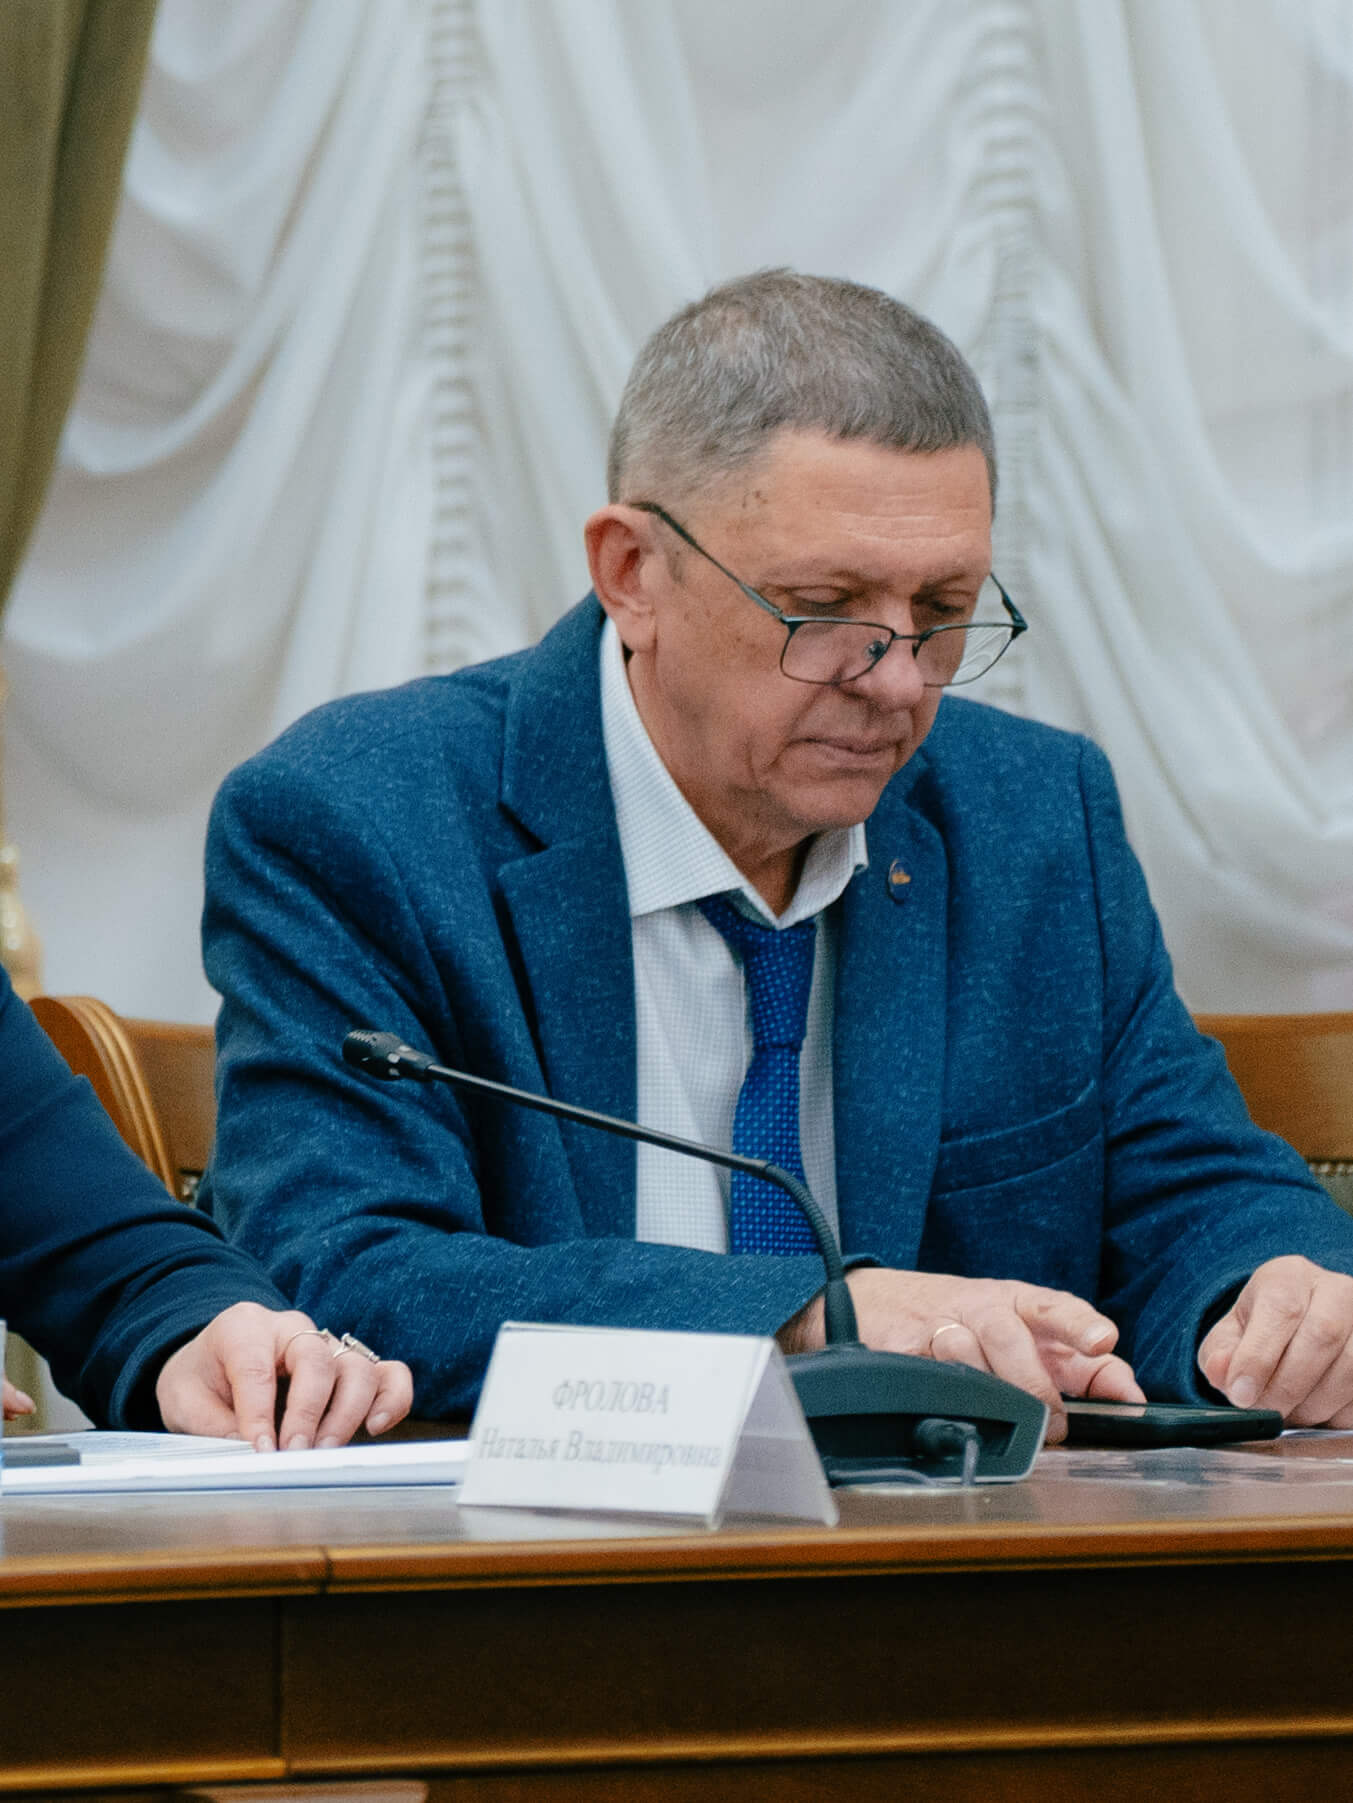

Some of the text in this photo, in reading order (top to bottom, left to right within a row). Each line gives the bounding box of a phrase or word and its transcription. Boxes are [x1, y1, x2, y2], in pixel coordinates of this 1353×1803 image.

[553, 1378, 671, 1414] ФРОЛОВА
[478, 1427, 721, 1473] Наталья Владимировна
